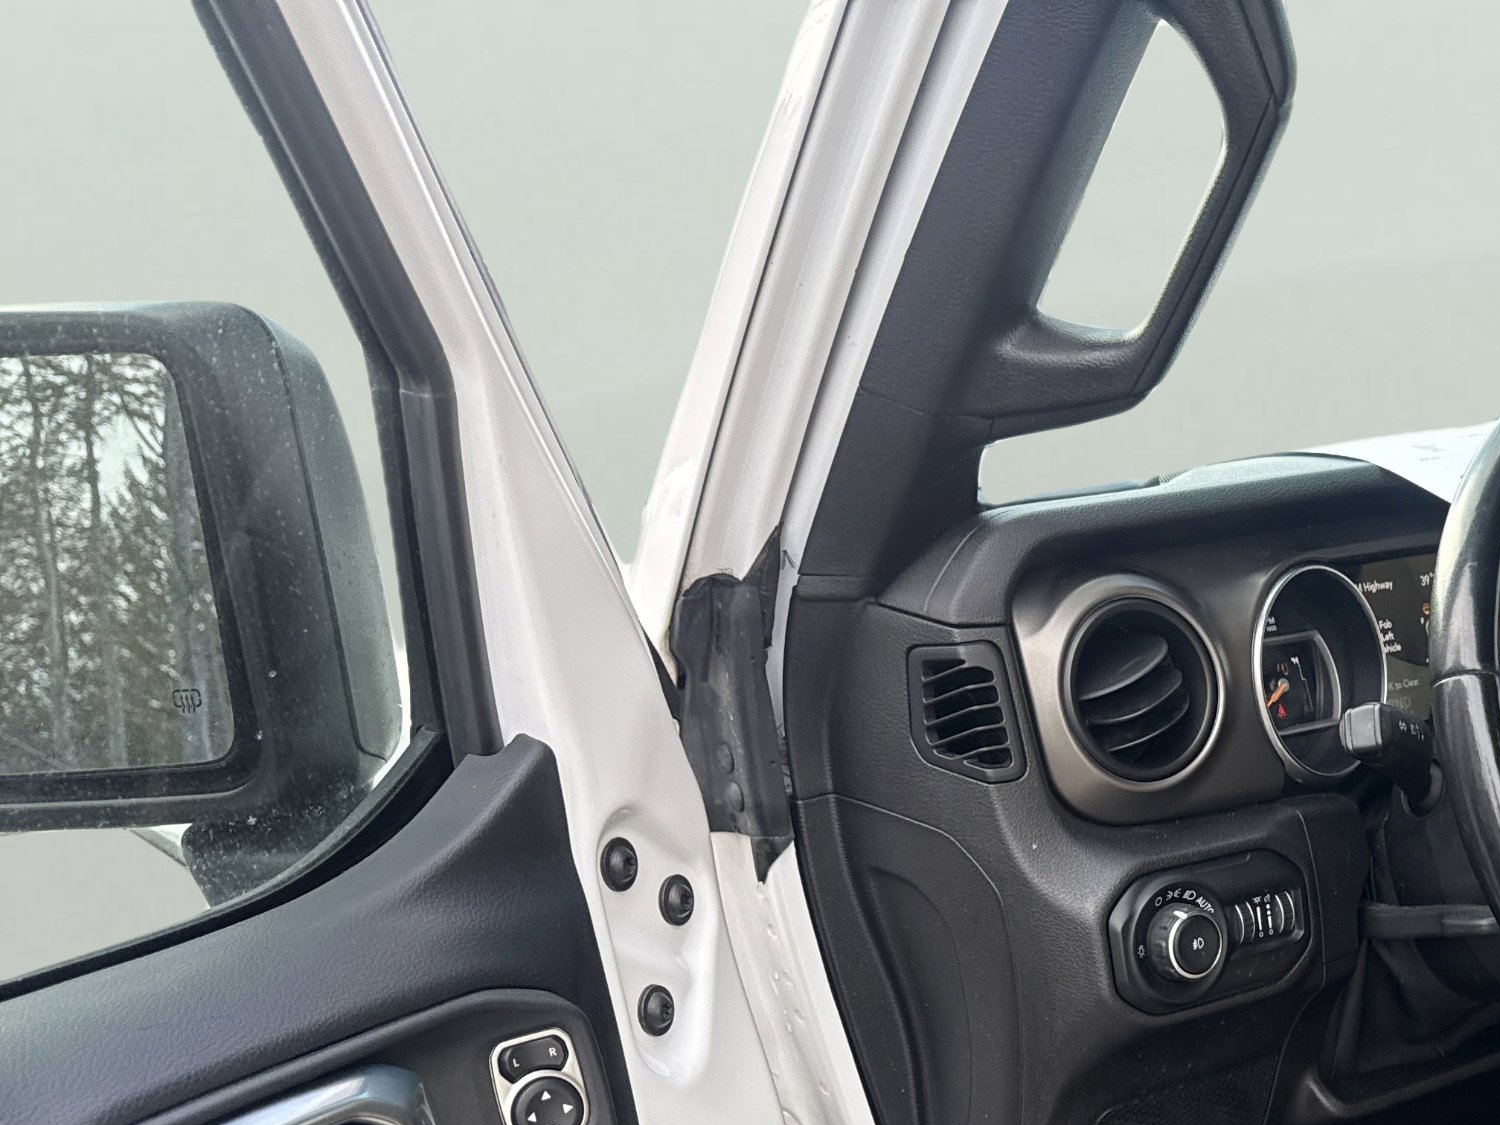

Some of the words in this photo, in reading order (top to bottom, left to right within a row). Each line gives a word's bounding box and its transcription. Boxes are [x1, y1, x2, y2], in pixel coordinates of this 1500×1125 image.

[1363, 580, 1393, 593] Highway
[1378, 619, 1392, 630] Fob
[548, 1047, 558, 1057] R
[512, 1058, 520, 1068] L
